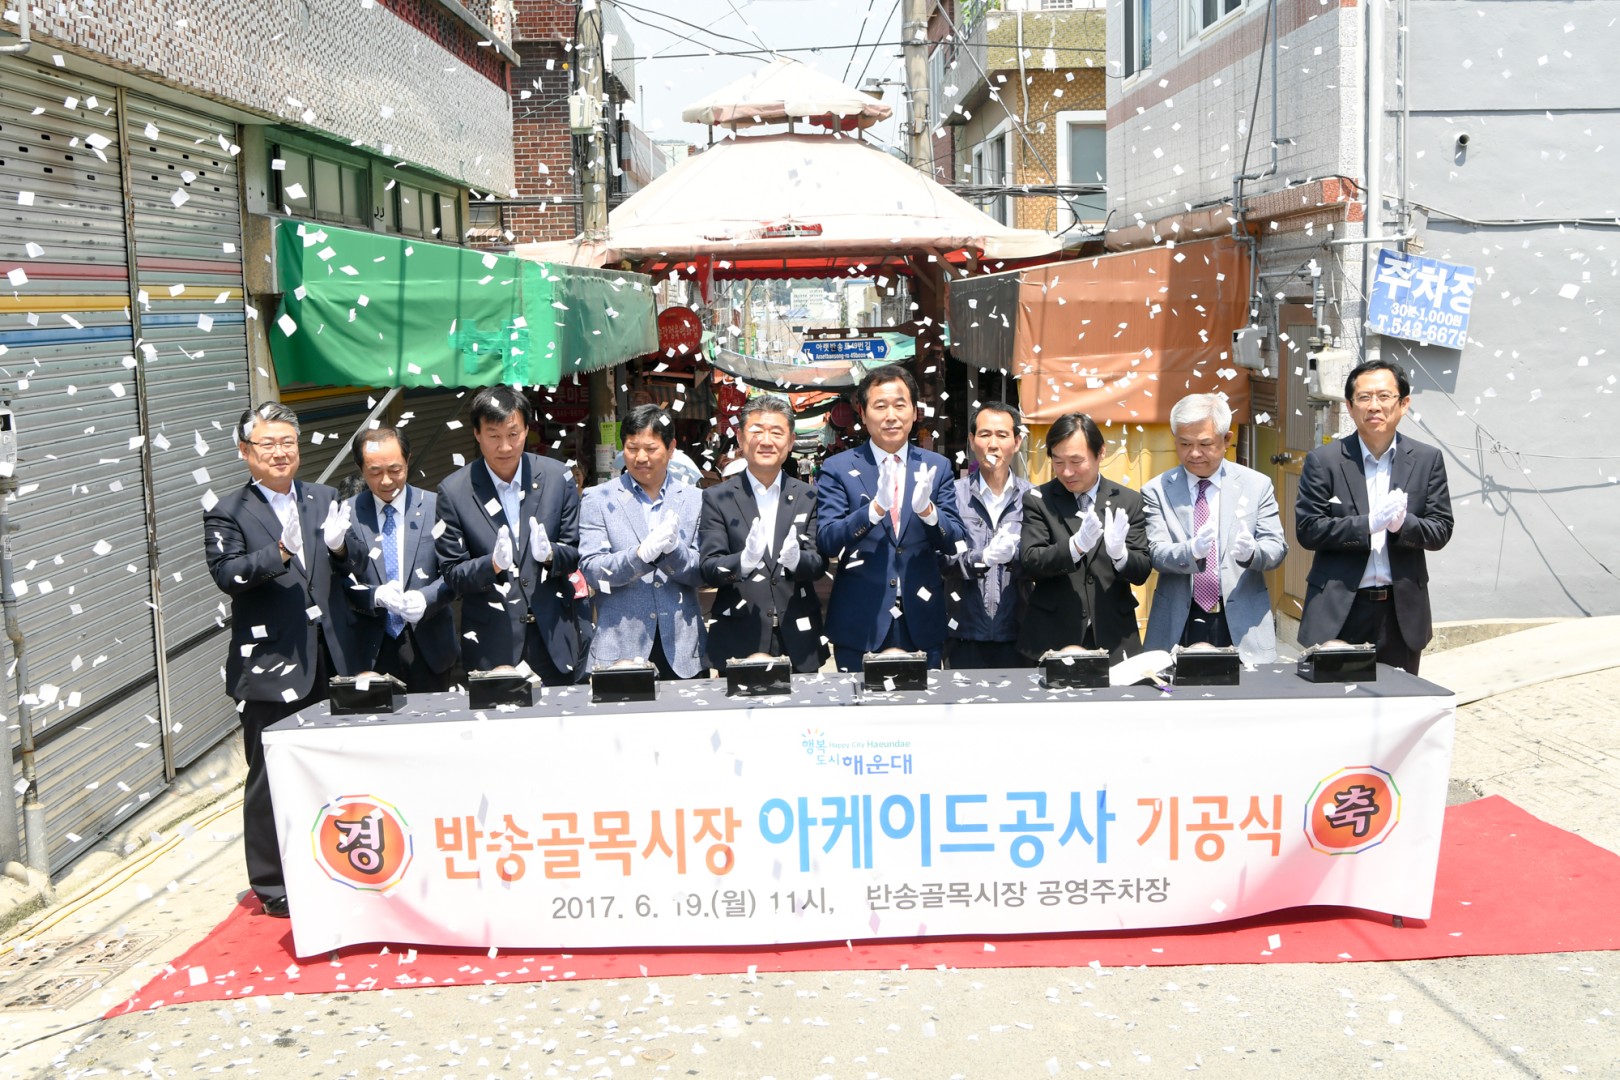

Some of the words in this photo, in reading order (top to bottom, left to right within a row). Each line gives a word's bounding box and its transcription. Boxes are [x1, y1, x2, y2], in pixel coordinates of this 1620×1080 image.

[801, 739, 827, 755] 행복
[816, 753, 840, 766] 도시
[842, 754, 913, 776] 해운대
[852, 741, 865, 749] City
[867, 740, 911, 748] Haeundae
[1331, 785, 1379, 838] 축
[335, 816, 385, 874] 경
[434, 806, 742, 882] 반송골목시장
[759, 790, 1116, 872] 아케이드공사
[1136, 794, 1283, 862] 기공식
[552, 896, 624, 919] 2017.
[635, 894, 659, 918] 6.
[866, 881, 1027, 911] 반송골목시장
[1037, 877, 1171, 906] 공영주차장
